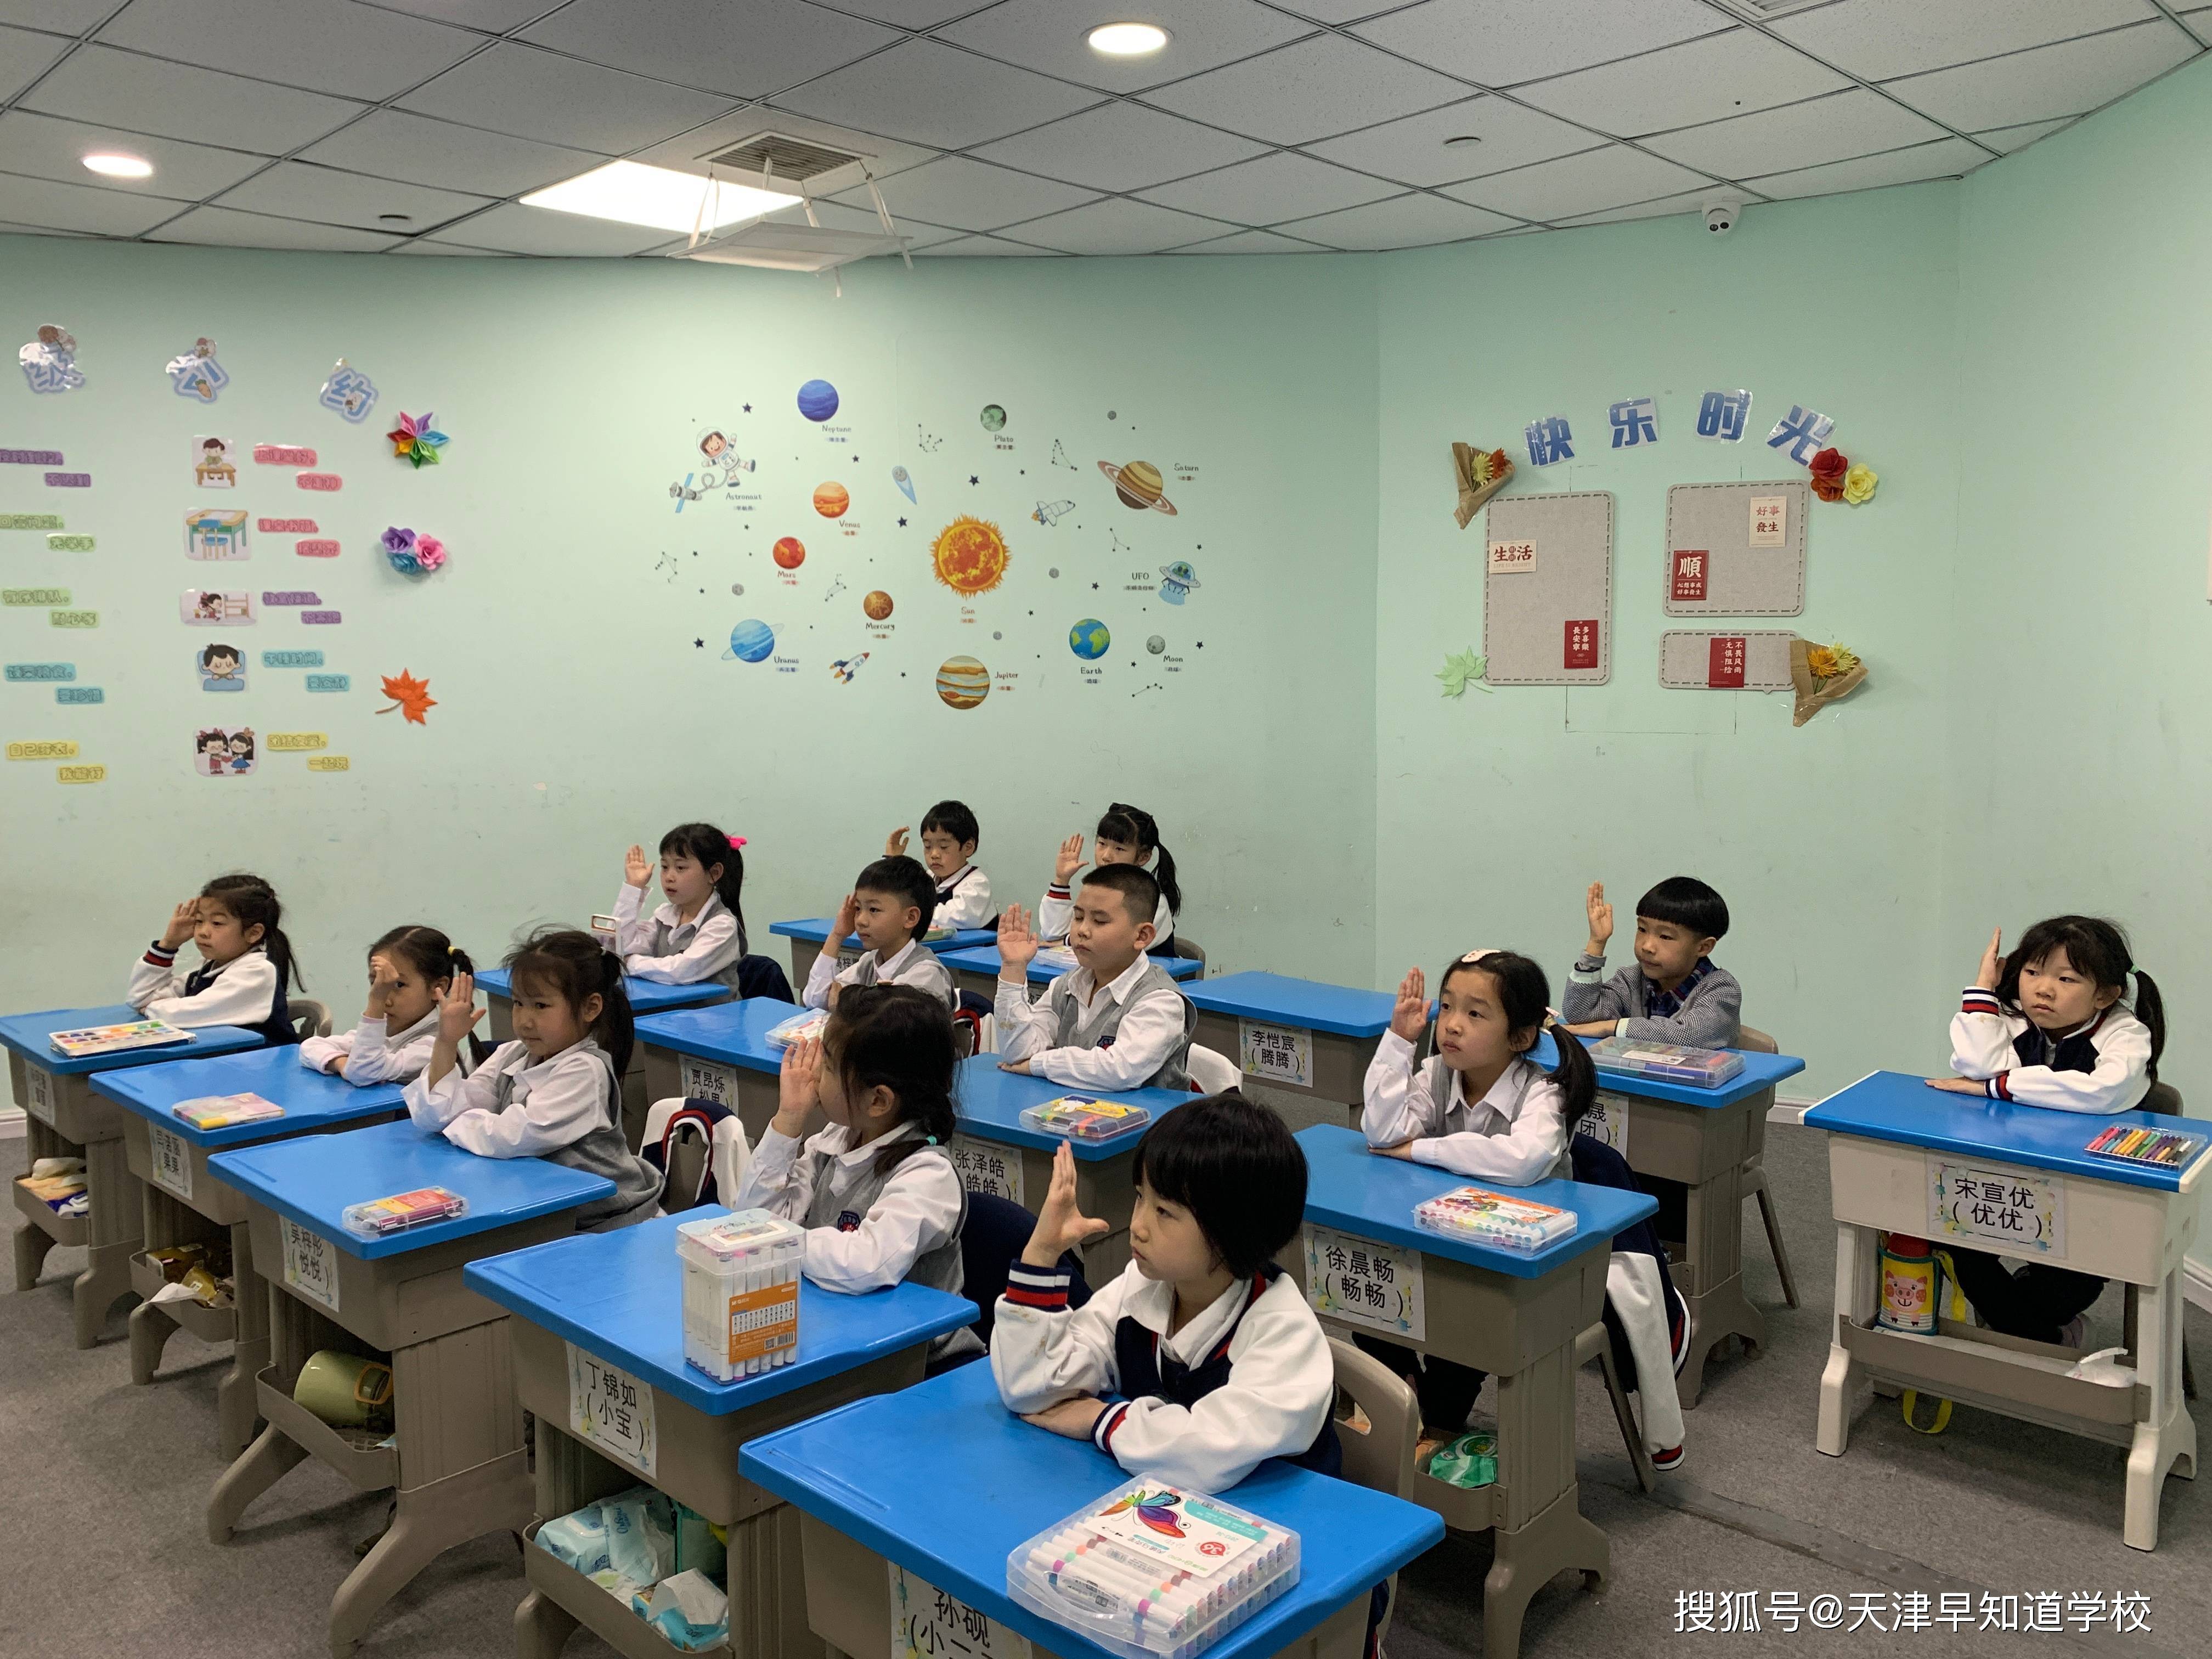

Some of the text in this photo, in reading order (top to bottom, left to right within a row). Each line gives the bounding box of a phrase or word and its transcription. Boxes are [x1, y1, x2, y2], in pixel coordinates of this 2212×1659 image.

[1525, 391, 1835, 467] 快乐时光
[994, 434, 1014, 442] Pluto
[1173, 464, 1199, 472] Saturn
[725, 492, 762, 500] Astronaut
[1756, 505, 1780, 516] 好事
[839, 520, 861, 528] Venus
[1756, 521, 1779, 533] 發生
[1678, 556, 1702, 578] 順
[961, 606, 975, 614] Sun
[866, 622, 895, 631] Mercury
[774, 656, 799, 664] Uranus
[1724, 641, 1734, 674] 无惧阻险
[1734, 641, 1743, 674] 不畏风雨
[995, 671, 1019, 680] Jupiter
[1252, 1030, 1295, 1052] 李恺宸
[691, 1068, 725, 1093] 贾昂烁
[955, 1149, 1005, 1179] 张泽皓
[1955, 1178, 2034, 1209] 宋宣优
[1325, 1245, 1394, 1283] 徐晨畅
[585, 1361, 637, 1409] 丁锦如
[1200, 1543, 1223, 1555] 36
[933, 1585, 991, 1649] 孙砚
